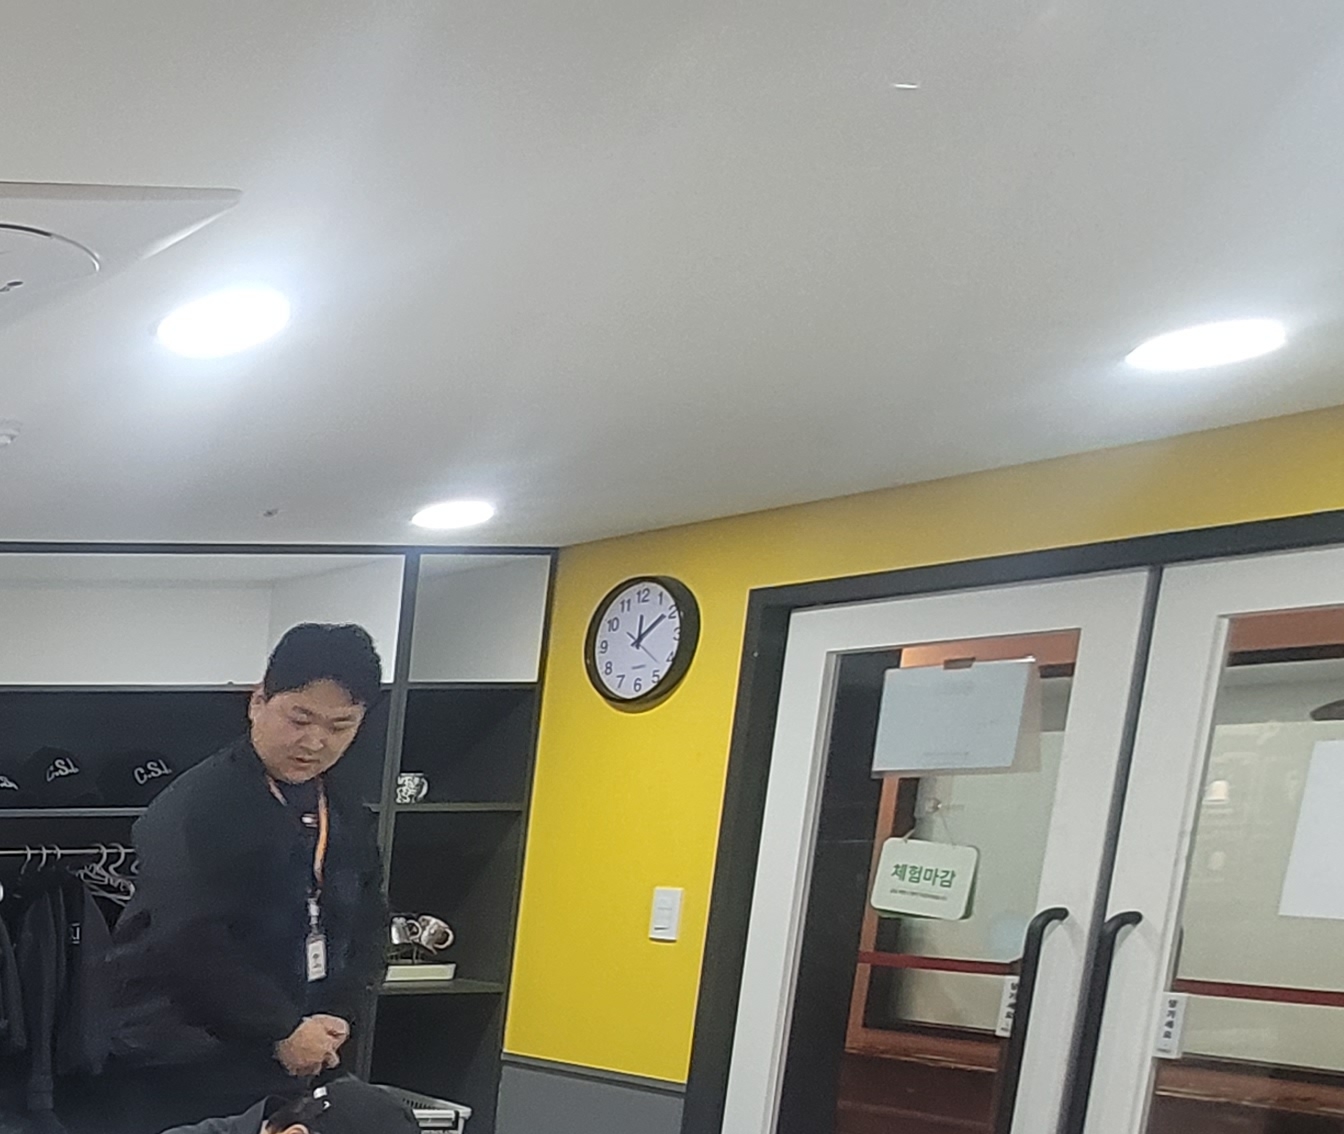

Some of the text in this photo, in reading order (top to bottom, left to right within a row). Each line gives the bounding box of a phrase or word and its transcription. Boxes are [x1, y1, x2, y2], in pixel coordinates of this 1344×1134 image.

[636, 588, 651, 604] 12
[658, 591, 664, 606] 1
[620, 598, 632, 613] 11
[668, 604, 678, 620] 2
[607, 617, 620, 632] 10
[673, 626, 681, 641] 3
[599, 640, 609, 654] 9
[605, 661, 613, 676] 8
[616, 674, 626, 689] 7
[651, 669, 661, 684] 5
[633, 678, 643, 692] 6
[890, 863, 956, 889] 체험마감
